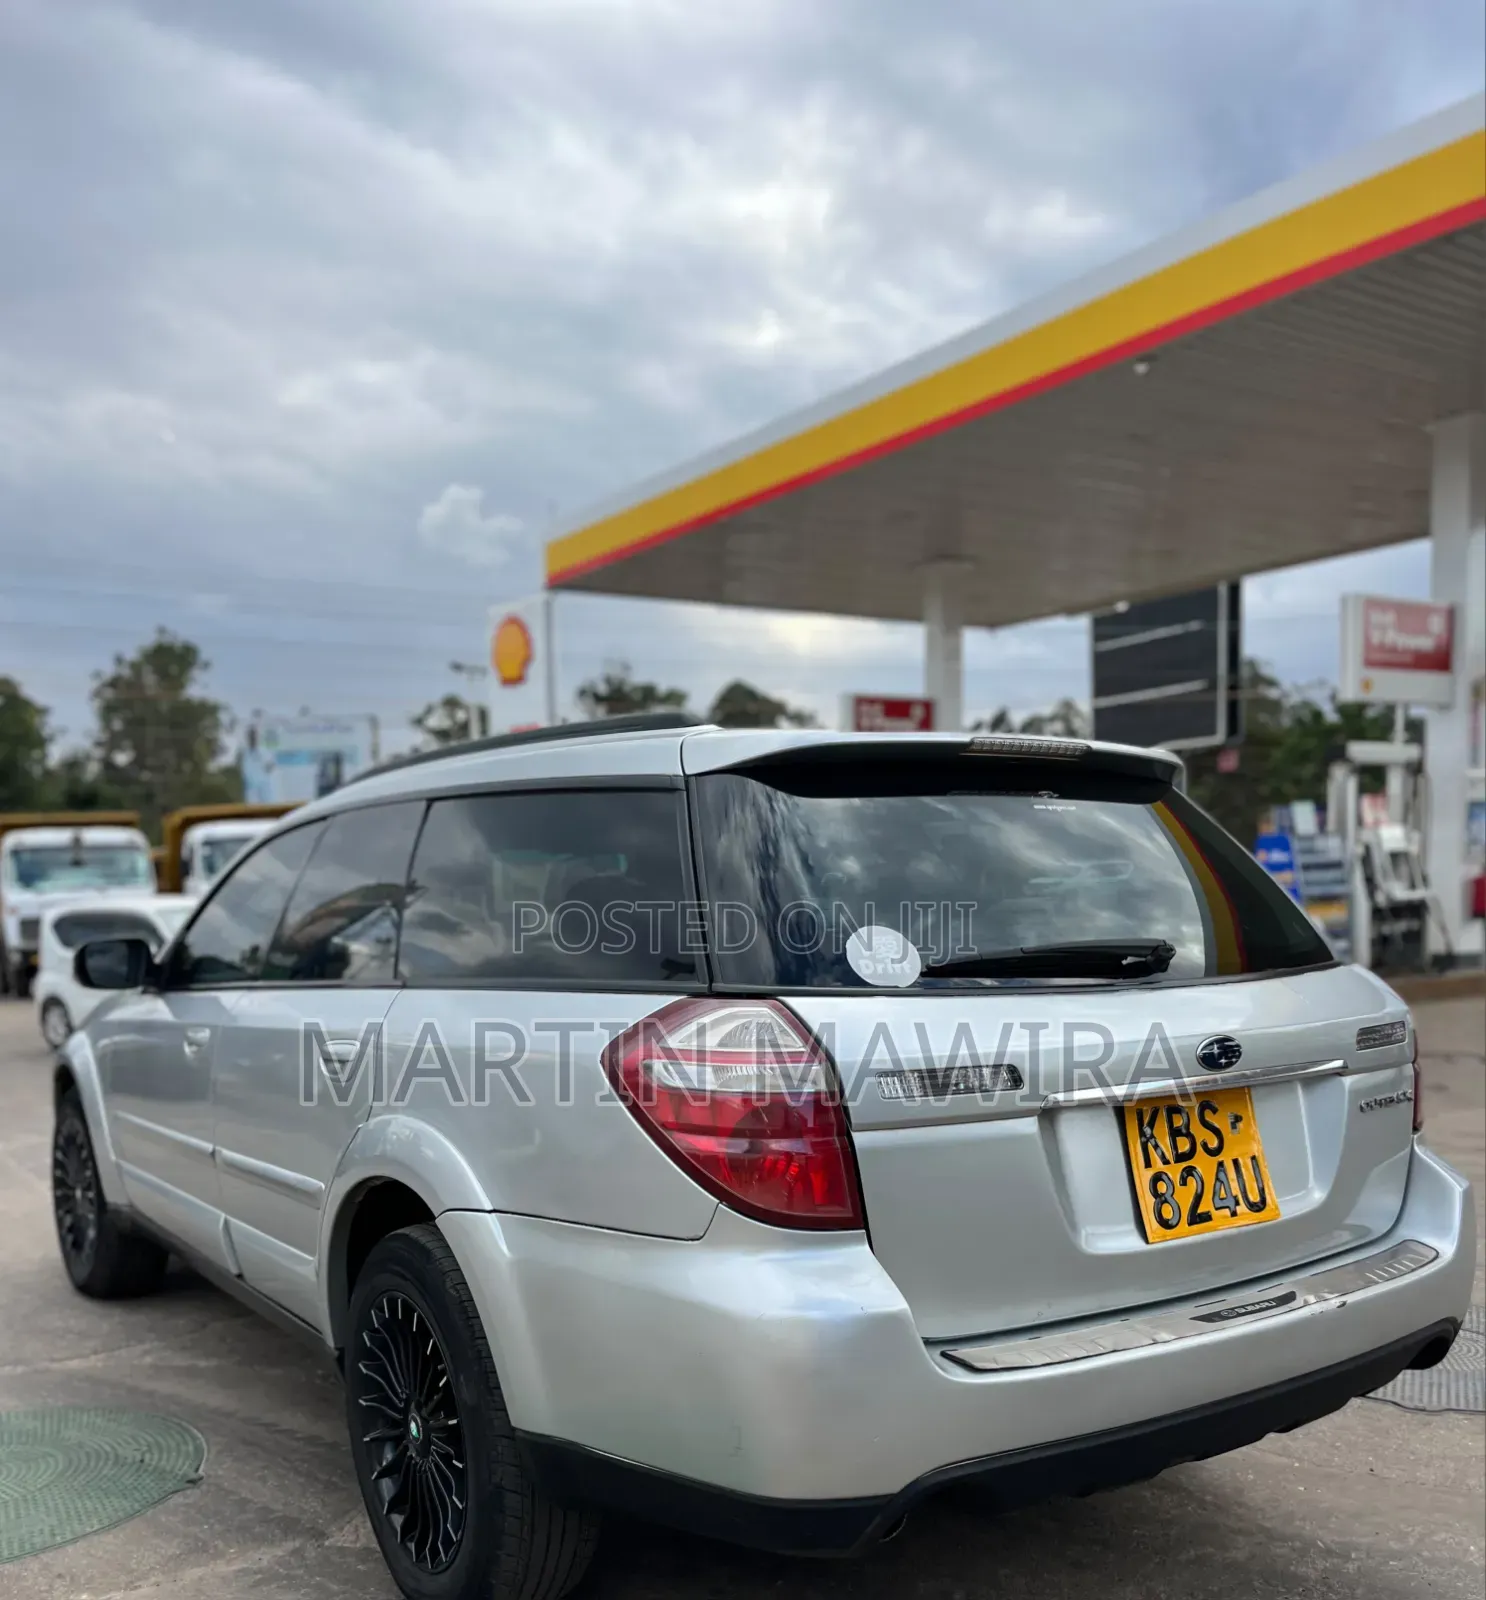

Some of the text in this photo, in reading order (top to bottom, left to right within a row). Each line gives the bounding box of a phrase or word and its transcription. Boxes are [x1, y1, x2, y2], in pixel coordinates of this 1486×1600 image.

[1136, 1100, 1225, 1169] KBS
[1149, 1155, 1267, 1230] 824U
[1235, 1300, 1277, 1313] SUBARU
